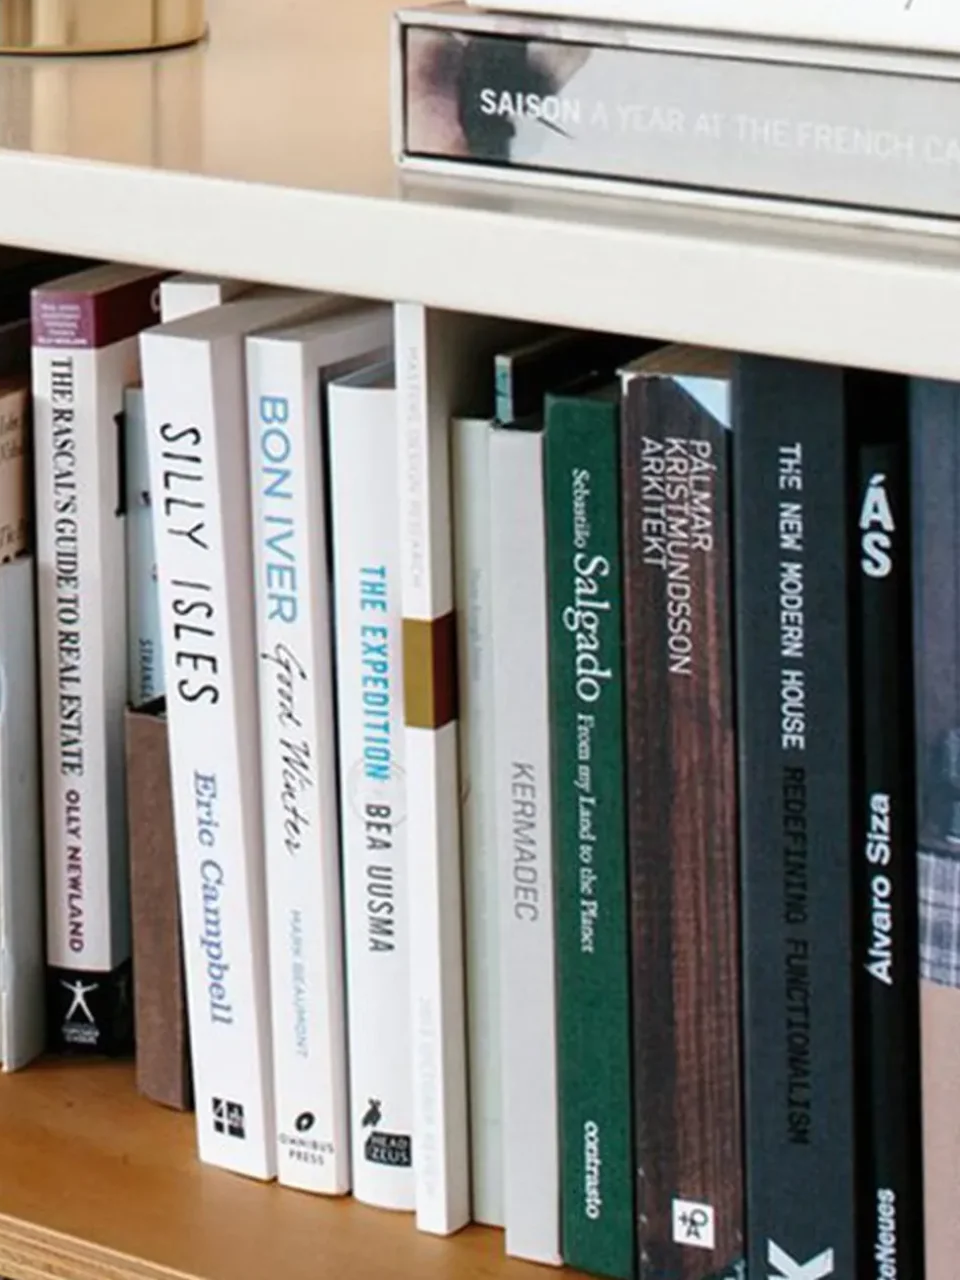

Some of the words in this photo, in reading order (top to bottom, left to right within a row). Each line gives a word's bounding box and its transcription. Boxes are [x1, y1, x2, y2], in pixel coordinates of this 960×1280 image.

[479, 88, 581, 124] SAISON
[591, 100, 609, 132] A
[616, 102, 687, 134] YEAR
[693, 111, 725, 140] AT
[730, 113, 790, 148] THE
[796, 121, 915, 160] FRENCH
[925, 134, 960, 169] CA
[51, 356, 74, 404] THE
[52, 407, 77, 513] RASCAL'S
[159, 422, 209, 550] SILLY
[259, 395, 294, 499] BON
[778, 442, 802, 490] THE
[642, 436, 667, 570] ARKITEKT
[690, 439, 718, 552] PÁLMAR
[779, 502, 803, 552] NEW
[54, 518, 79, 590] GUIDE
[264, 515, 299, 624] IVER
[359, 565, 386, 613] THE
[665, 437, 692, 675] KRISTMUNDSSON
[57, 594, 81, 625] TO
[171, 579, 220, 704] ISLES
[563, 553, 612, 702] Salgado
[780, 562, 804, 658] MODERN
[57, 630, 82, 690] REAL
[261, 642, 307, 728] Good
[58, 694, 84, 779] ESTATE
[361, 624, 391, 783] EXPEDITION
[577, 713, 595, 761] From
[781, 669, 805, 750] HOUSE
[65, 789, 82, 839] OLLY
[194, 769, 220, 848] Eric
[279, 738, 313, 857] Winter
[574, 764, 591, 794] my
[579, 796, 597, 842] Land
[365, 803, 392, 851] BEA
[511, 761, 539, 922] KERMADEC
[579, 844, 593, 864] to
[783, 766, 808, 925] REDEFINING
[866, 793, 891, 866] Siza
[66, 845, 85, 953] NEWLAND
[367, 864, 395, 953] UUSMA
[580, 867, 597, 895] the
[200, 858, 234, 1026] Campbell
[581, 899, 598, 954] Planet
[864, 875, 893, 986] Álvaro
[785, 938, 811, 1145] FUNCTIONALISM
[279, 1133, 334, 1155] OMNIBUS
[289, 1149, 325, 1166] PRESS
[369, 1146, 410, 1165] ZEUS
[584, 1120, 602, 1219] contrasto
[875, 1188, 897, 1280] eNeues
